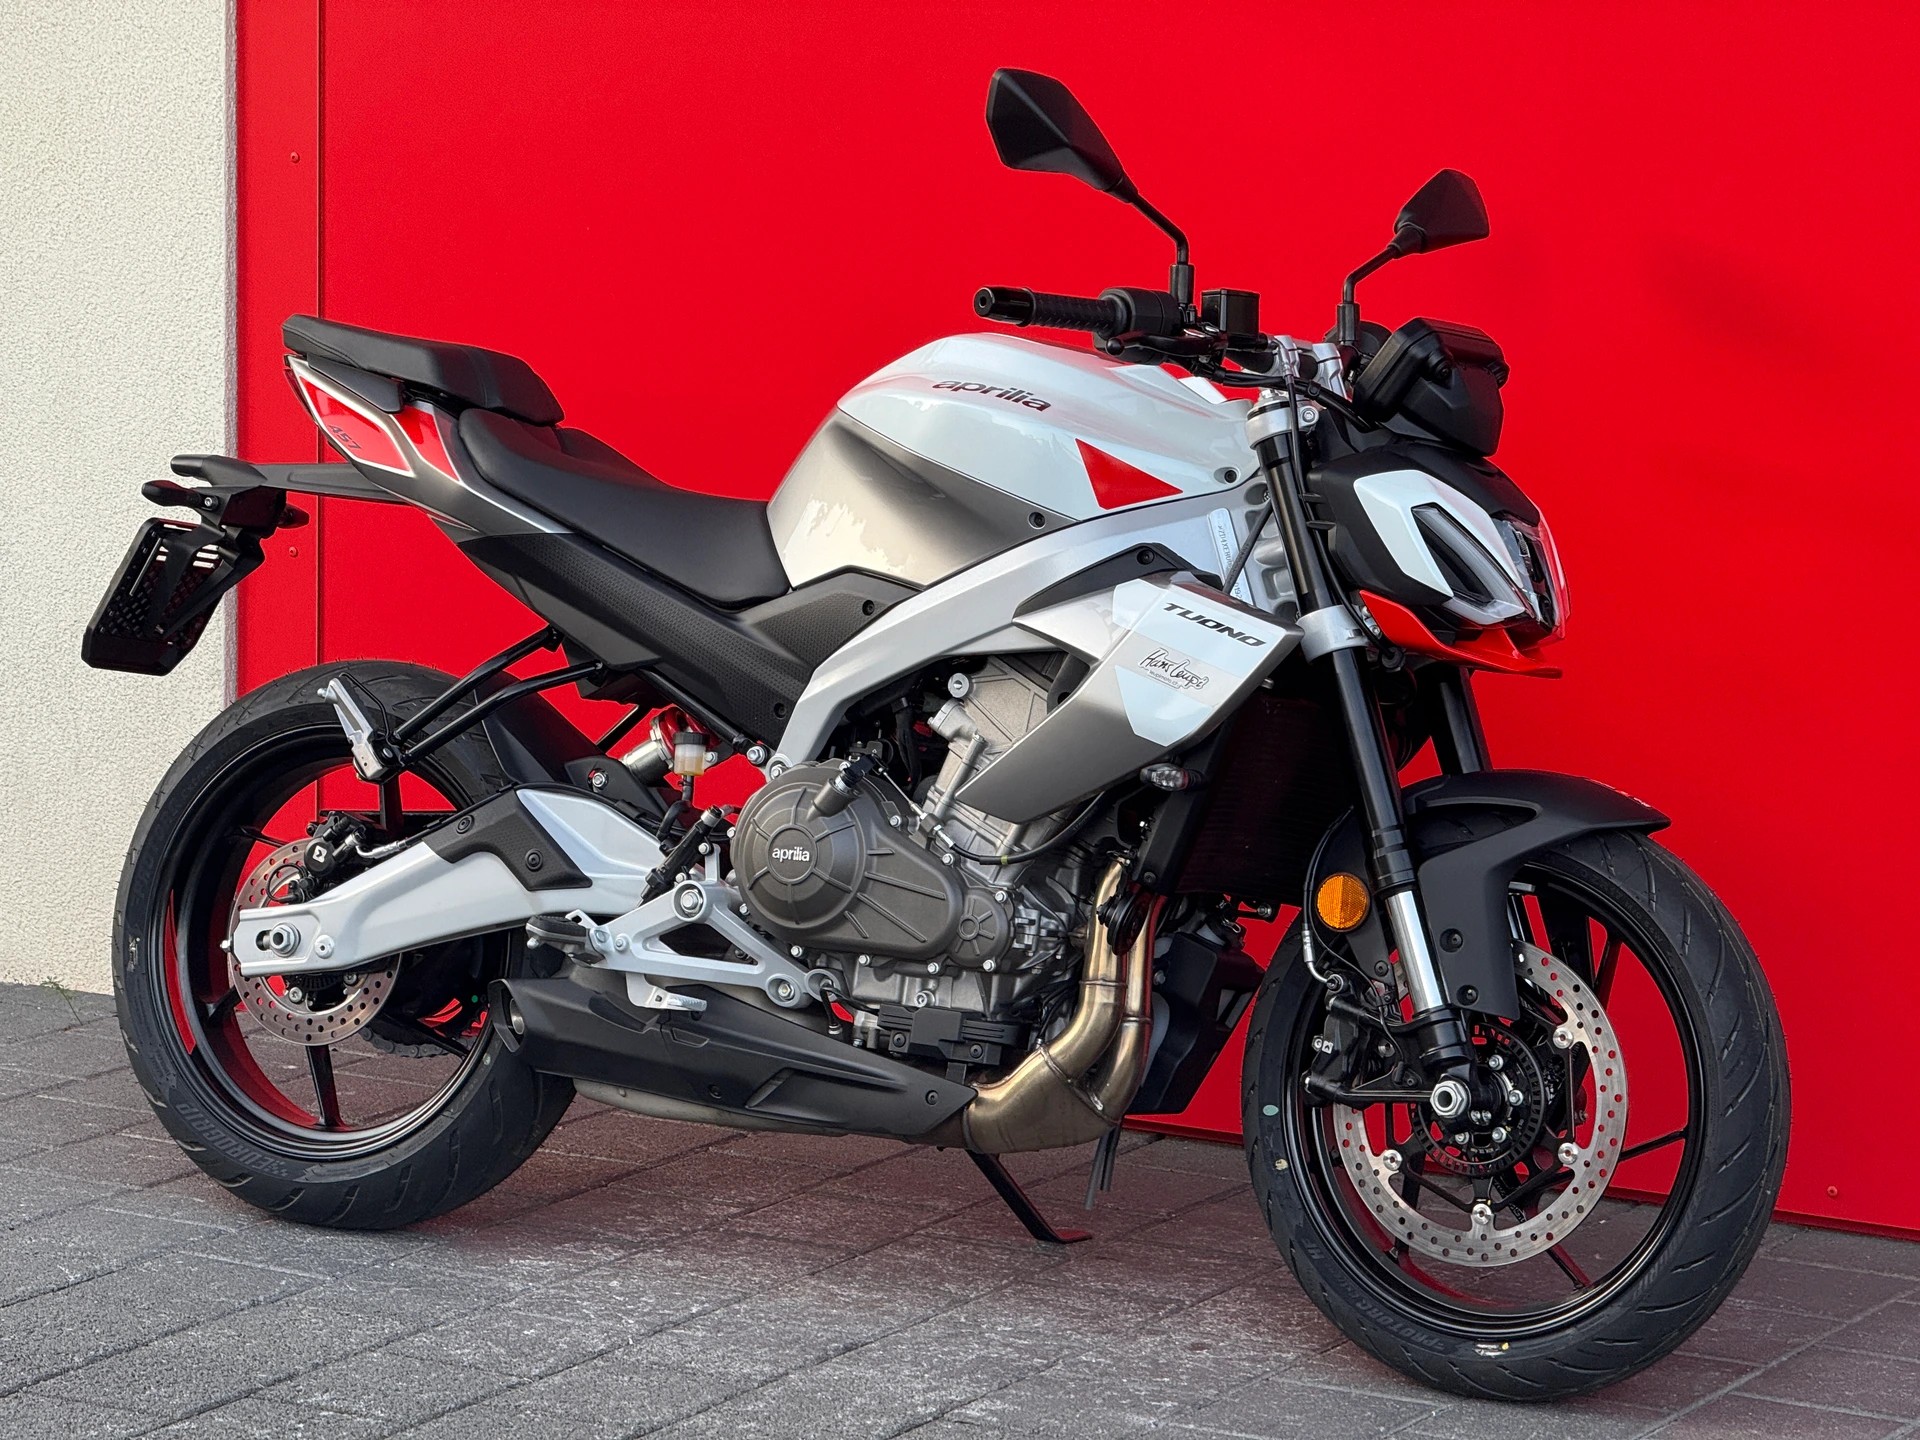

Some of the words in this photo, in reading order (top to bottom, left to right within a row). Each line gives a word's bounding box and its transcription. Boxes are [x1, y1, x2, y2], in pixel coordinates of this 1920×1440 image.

[932, 380, 1051, 412] aprilia
[328, 424, 362, 449] 457
[1163, 602, 1267, 647] TUONO
[1139, 649, 1174, 673] Hans
[1169, 660, 1207, 687] Leupi
[771, 846, 810, 863] aprilia
[175, 1102, 275, 1170] EUROGRIP
